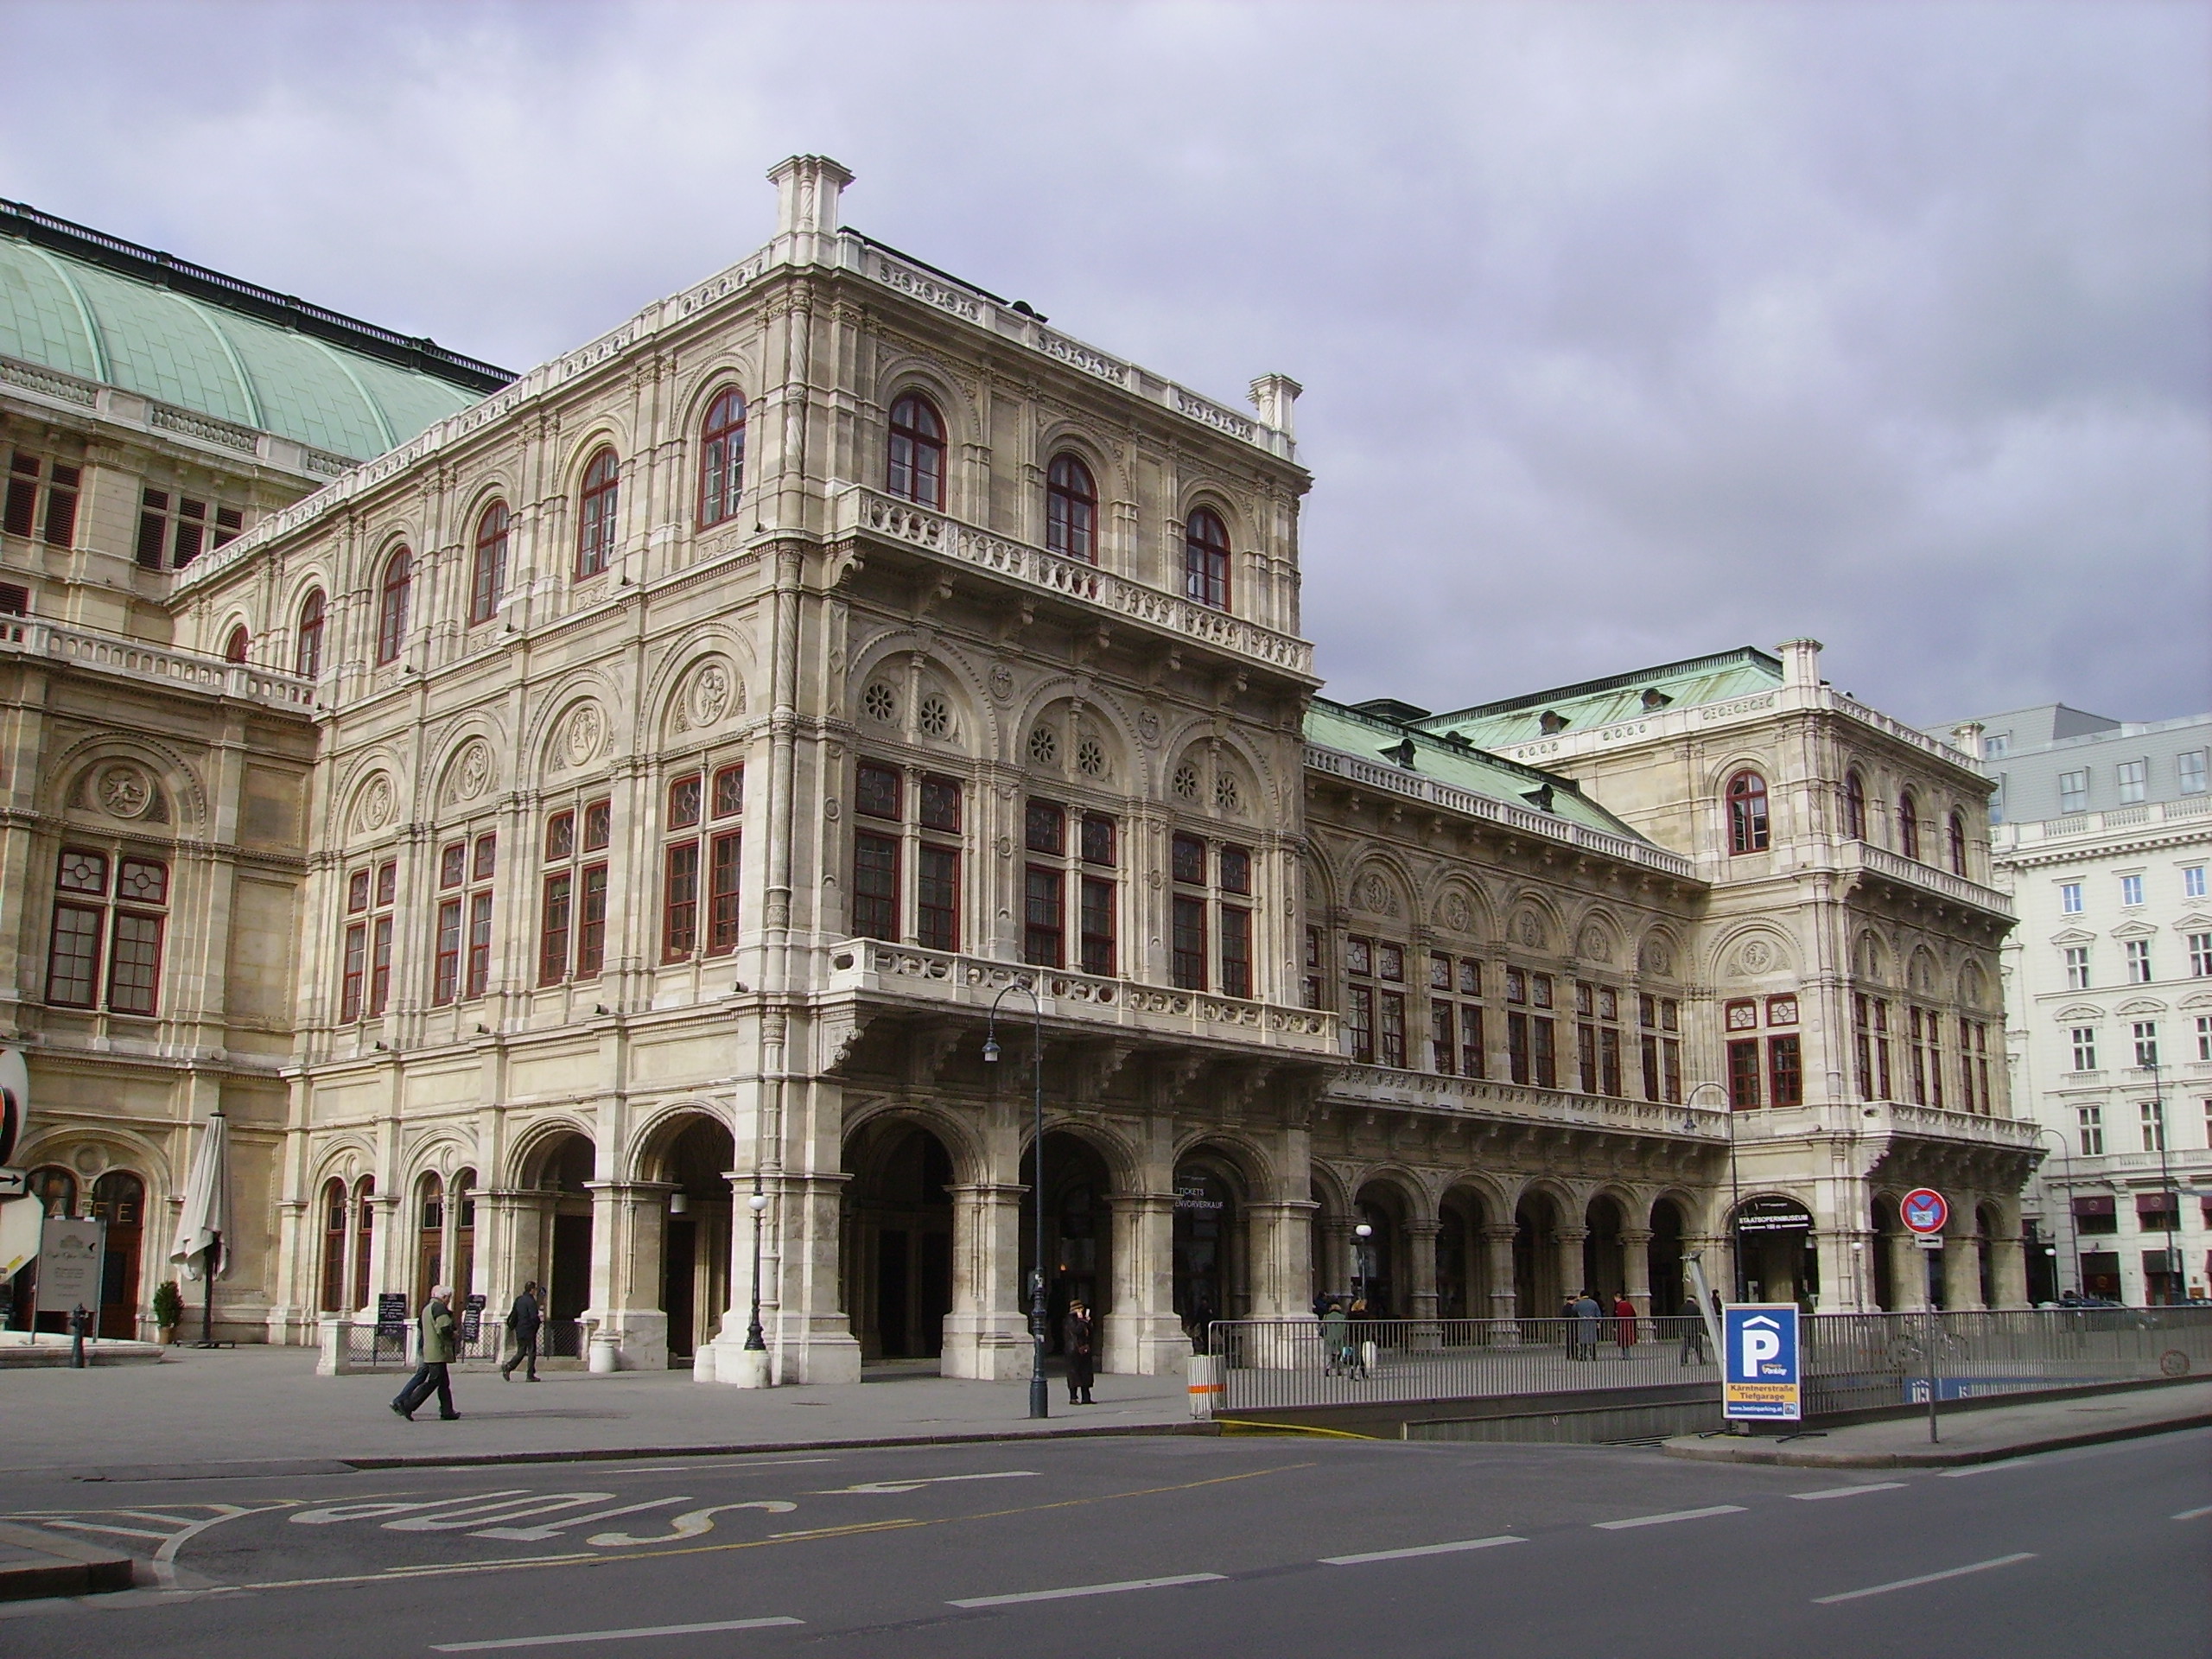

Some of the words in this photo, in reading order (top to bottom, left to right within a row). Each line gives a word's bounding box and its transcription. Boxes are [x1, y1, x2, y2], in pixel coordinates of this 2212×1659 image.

[1179, 1187, 1205, 1197] TICKETS
[1175, 1199, 1224, 1209] ENVORVERKAUF
[49, 1199, 133, 1223] AFE
[1742, 1329, 1780, 1377] P
[1730, 1384, 1795, 1393] Kärntnerstraße
[1739, 1392, 1785, 1401] Tiefgarage
